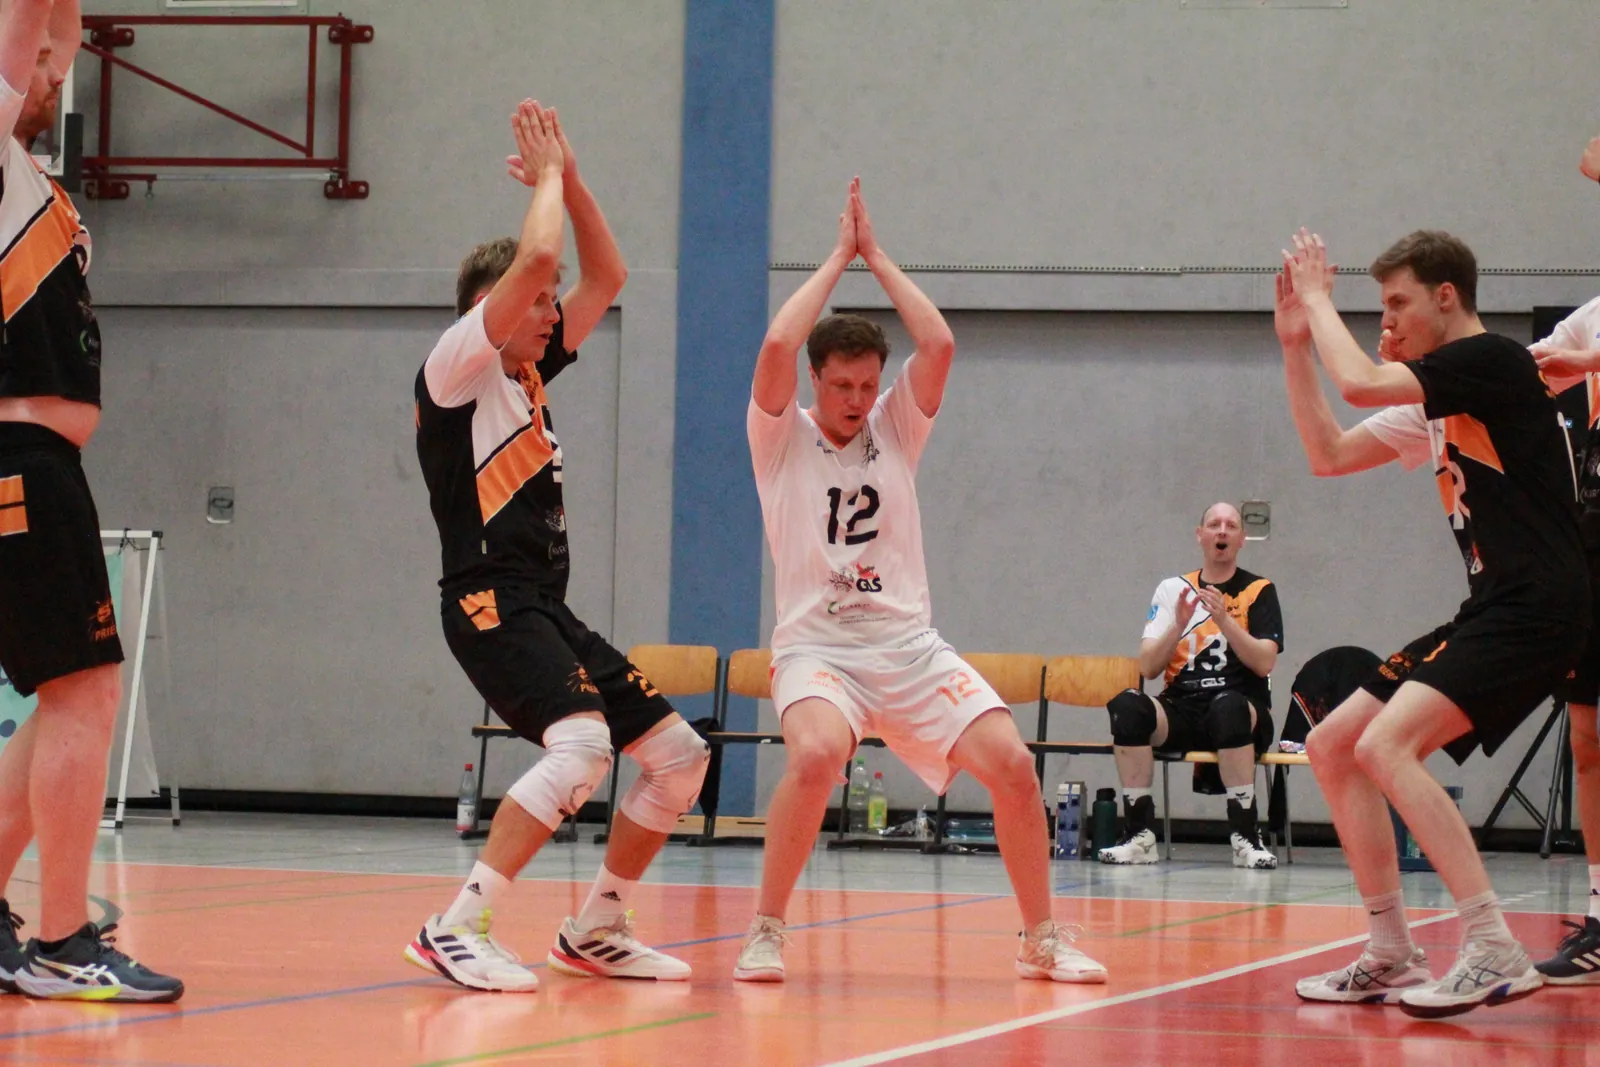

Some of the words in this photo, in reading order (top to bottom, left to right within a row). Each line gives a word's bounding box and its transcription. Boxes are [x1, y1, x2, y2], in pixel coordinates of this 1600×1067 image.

[827, 485, 880, 546] 12
[856, 578, 883, 592] GLS
[1187, 631, 1228, 671] 13
[936, 671, 981, 706] 12
